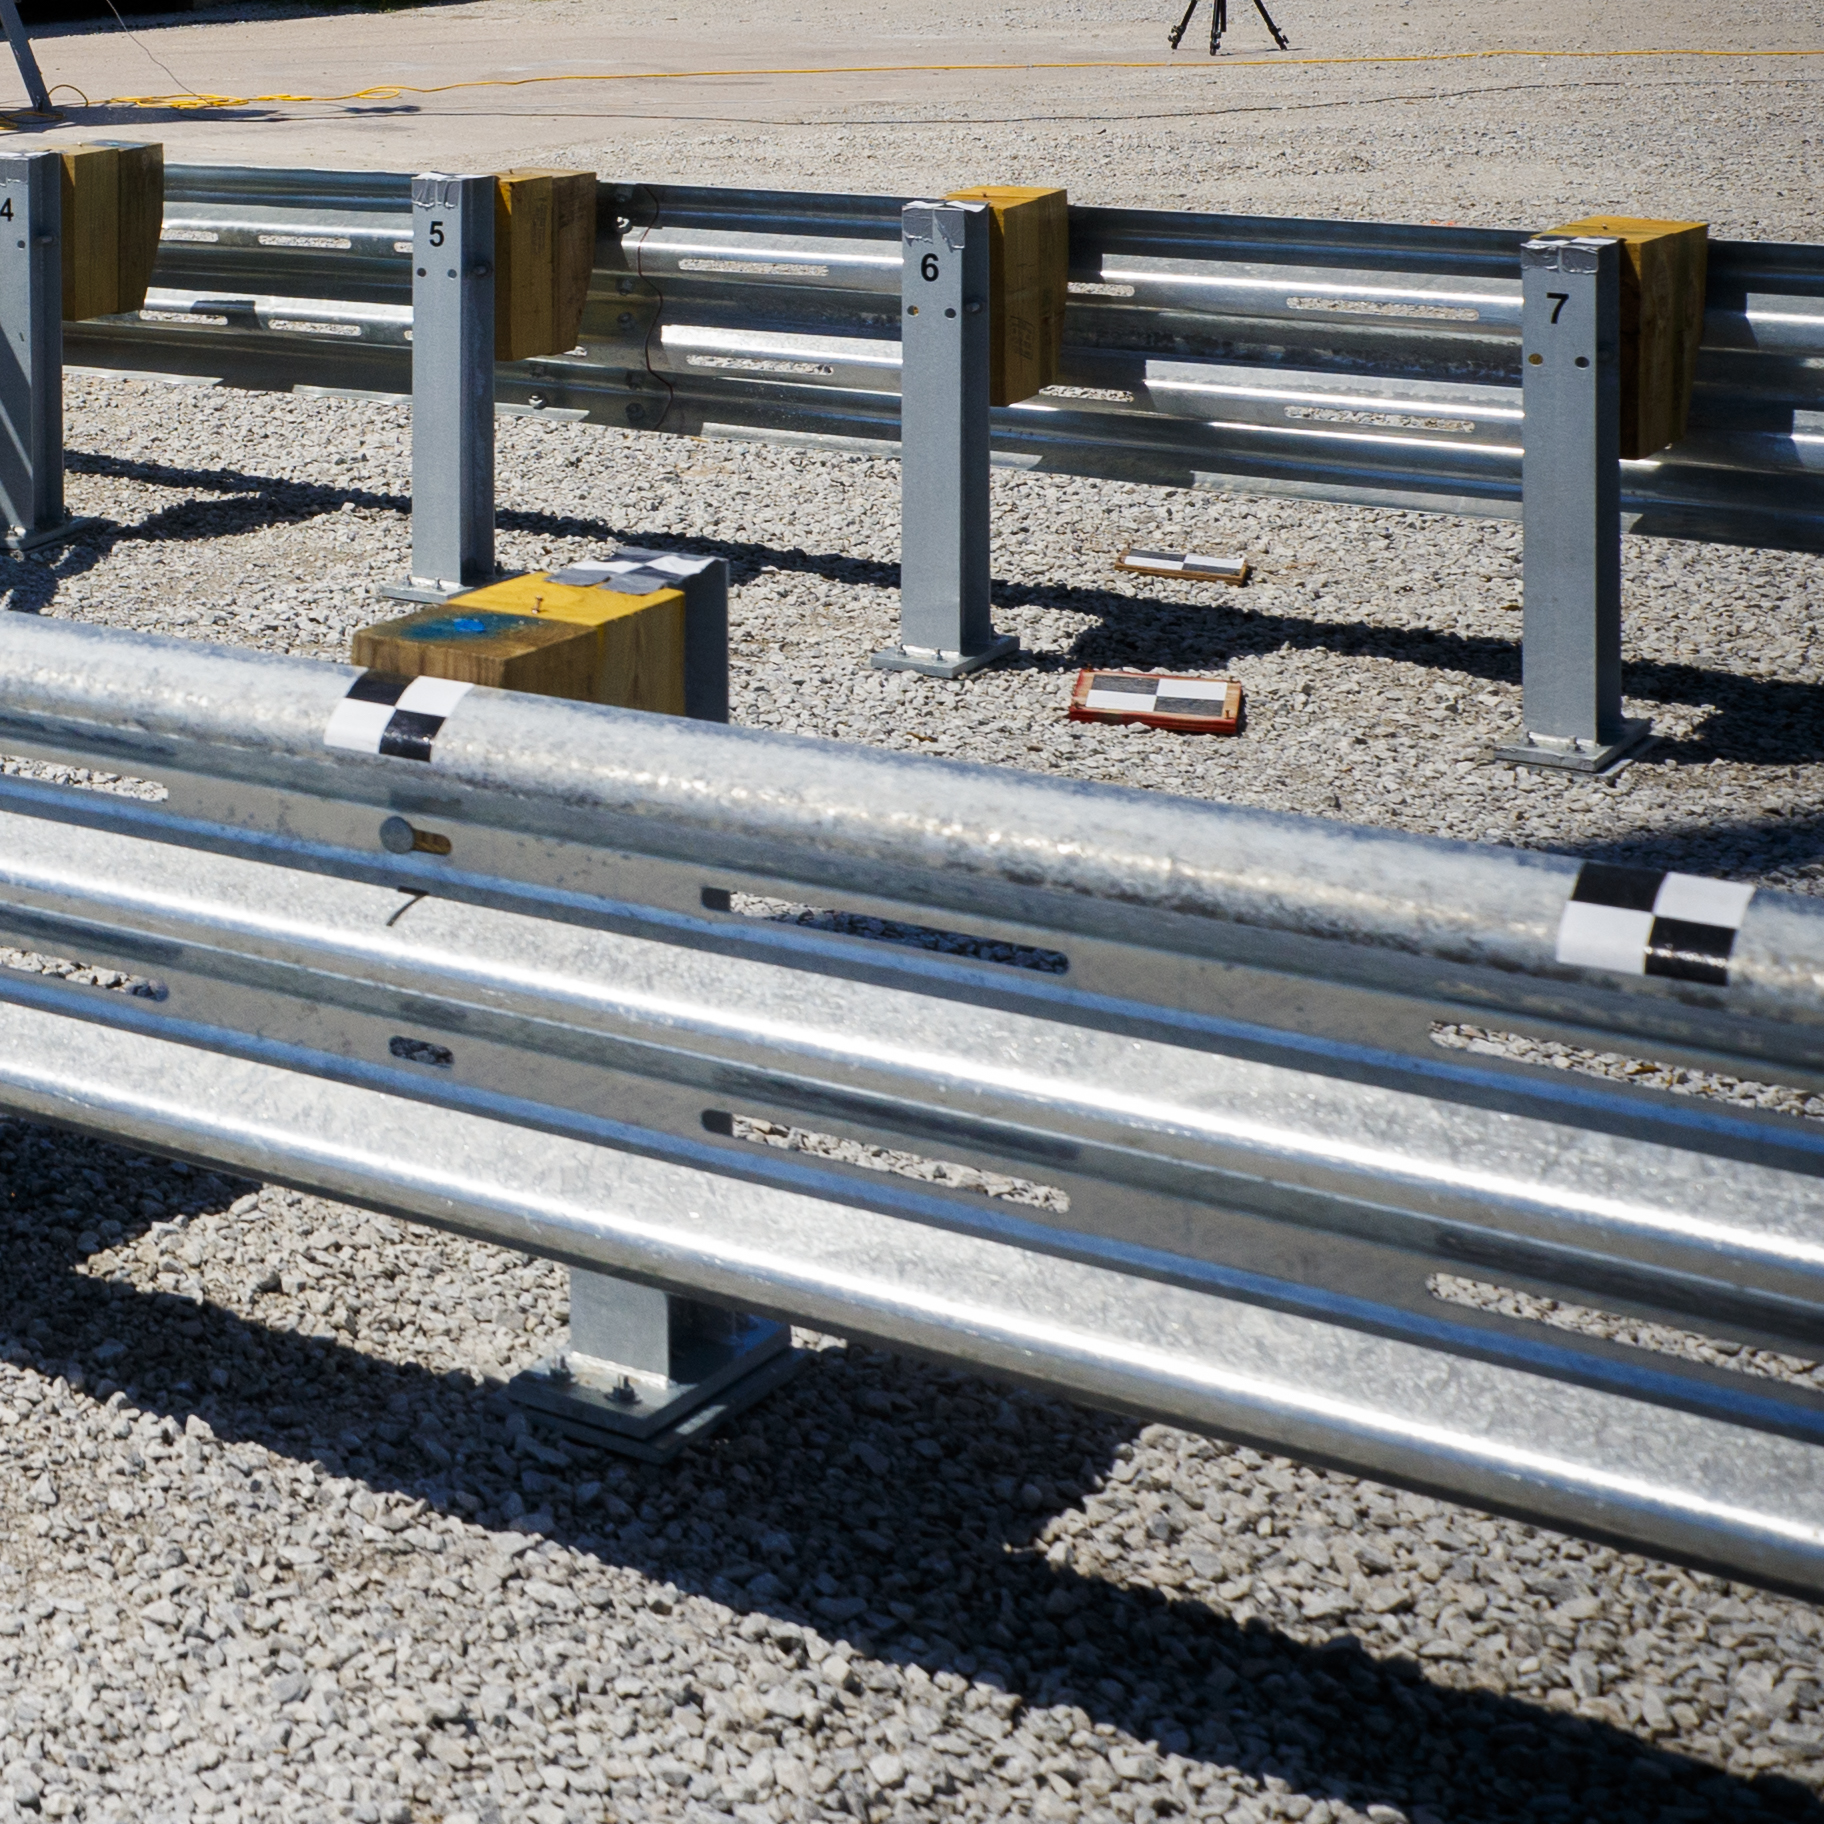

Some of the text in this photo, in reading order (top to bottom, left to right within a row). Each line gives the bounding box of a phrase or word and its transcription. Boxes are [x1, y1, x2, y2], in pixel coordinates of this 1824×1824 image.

[0, 197, 14, 222] 4
[429, 221, 444, 247] 5
[921, 253, 939, 282] 6
[1546, 292, 1569, 324] 7
[386, 885, 430, 927] 7
